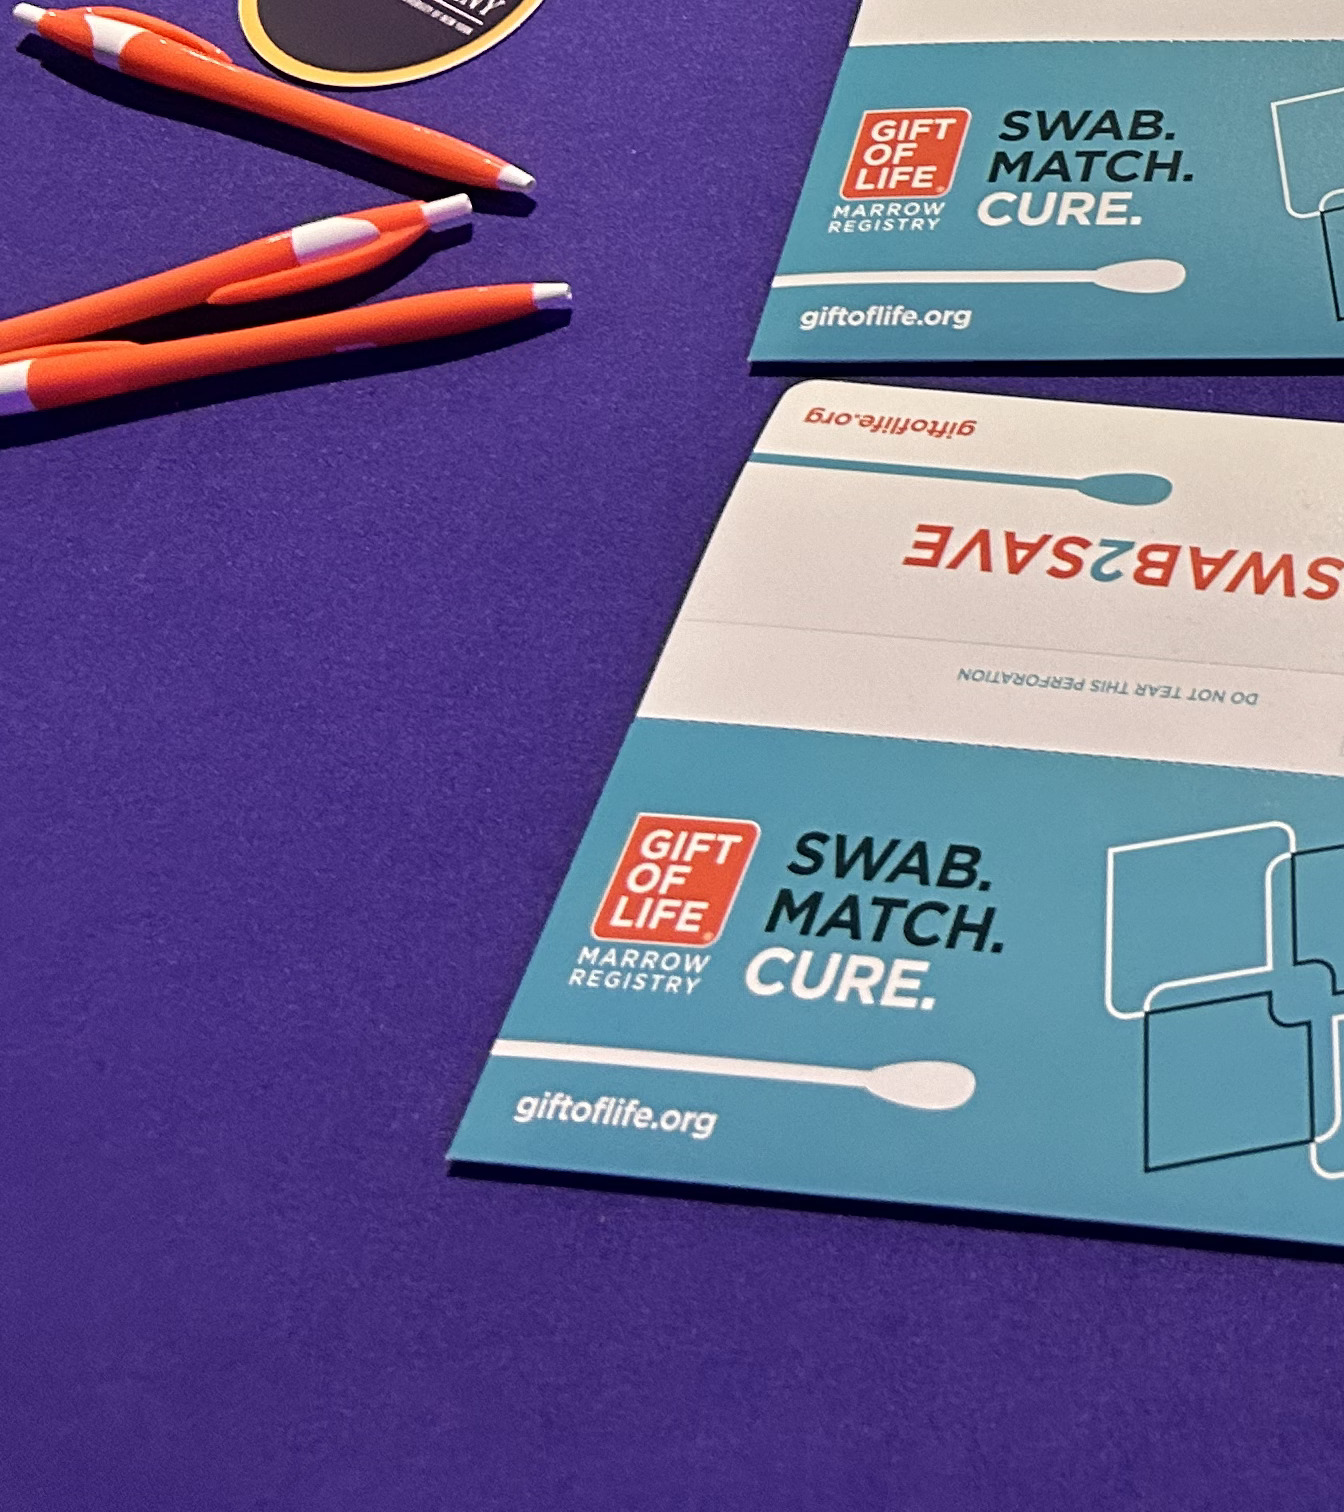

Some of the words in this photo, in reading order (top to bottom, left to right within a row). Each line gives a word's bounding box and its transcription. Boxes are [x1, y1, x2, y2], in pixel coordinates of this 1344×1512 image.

[871, 118, 957, 142] GIFT
[999, 109, 1175, 141] SWAB.
[863, 143, 918, 166] OF
[987, 150, 1193, 182] MATCH.
[855, 165, 937, 190] LIFE
[832, 202, 946, 219] MARROW
[977, 191, 1142, 226] CURE.
[827, 217, 942, 234] REGISTRY
[800, 305, 972, 331] giftoflife.org
[804, 407, 977, 437] giftoflife.org
[957, 668, 1085, 691] PERFORATION
[1135, 682, 1186, 700] TEAR
[641, 829, 743, 865] GIFT
[787, 830, 992, 892] SWAB.
[626, 862, 693, 895] OF
[610, 898, 710, 933] LIFE
[764, 888, 1004, 954] MATCH.
[577, 946, 711, 974] MARROW
[568, 967, 701, 995] REGISTRY
[745, 947, 935, 1011] CURE.
[513, 1091, 718, 1138] giftoflife.org
